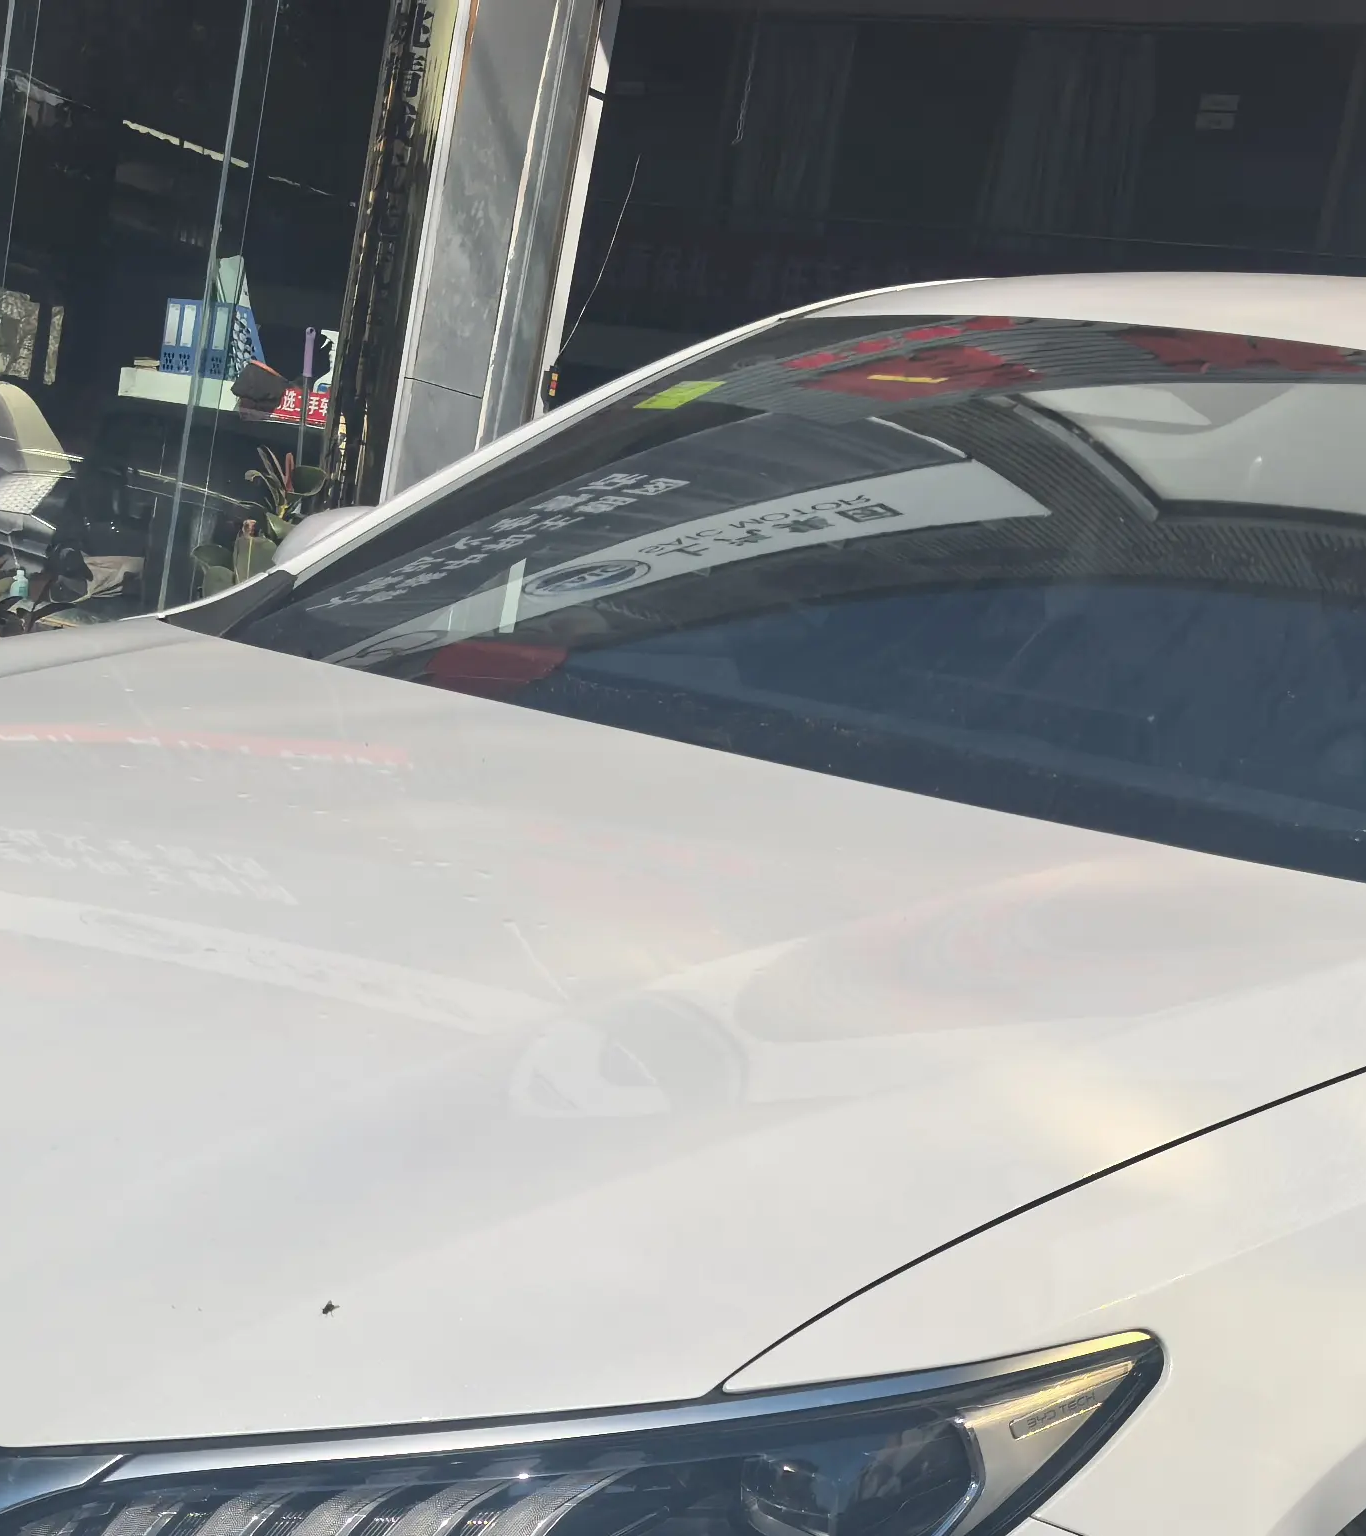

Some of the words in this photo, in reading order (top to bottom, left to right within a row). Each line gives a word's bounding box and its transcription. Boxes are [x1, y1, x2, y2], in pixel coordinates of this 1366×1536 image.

[276, 388, 329, 417] 选二手车
[1027, 1409, 1056, 1430] BYD
[1059, 1390, 1096, 1413] TECH
